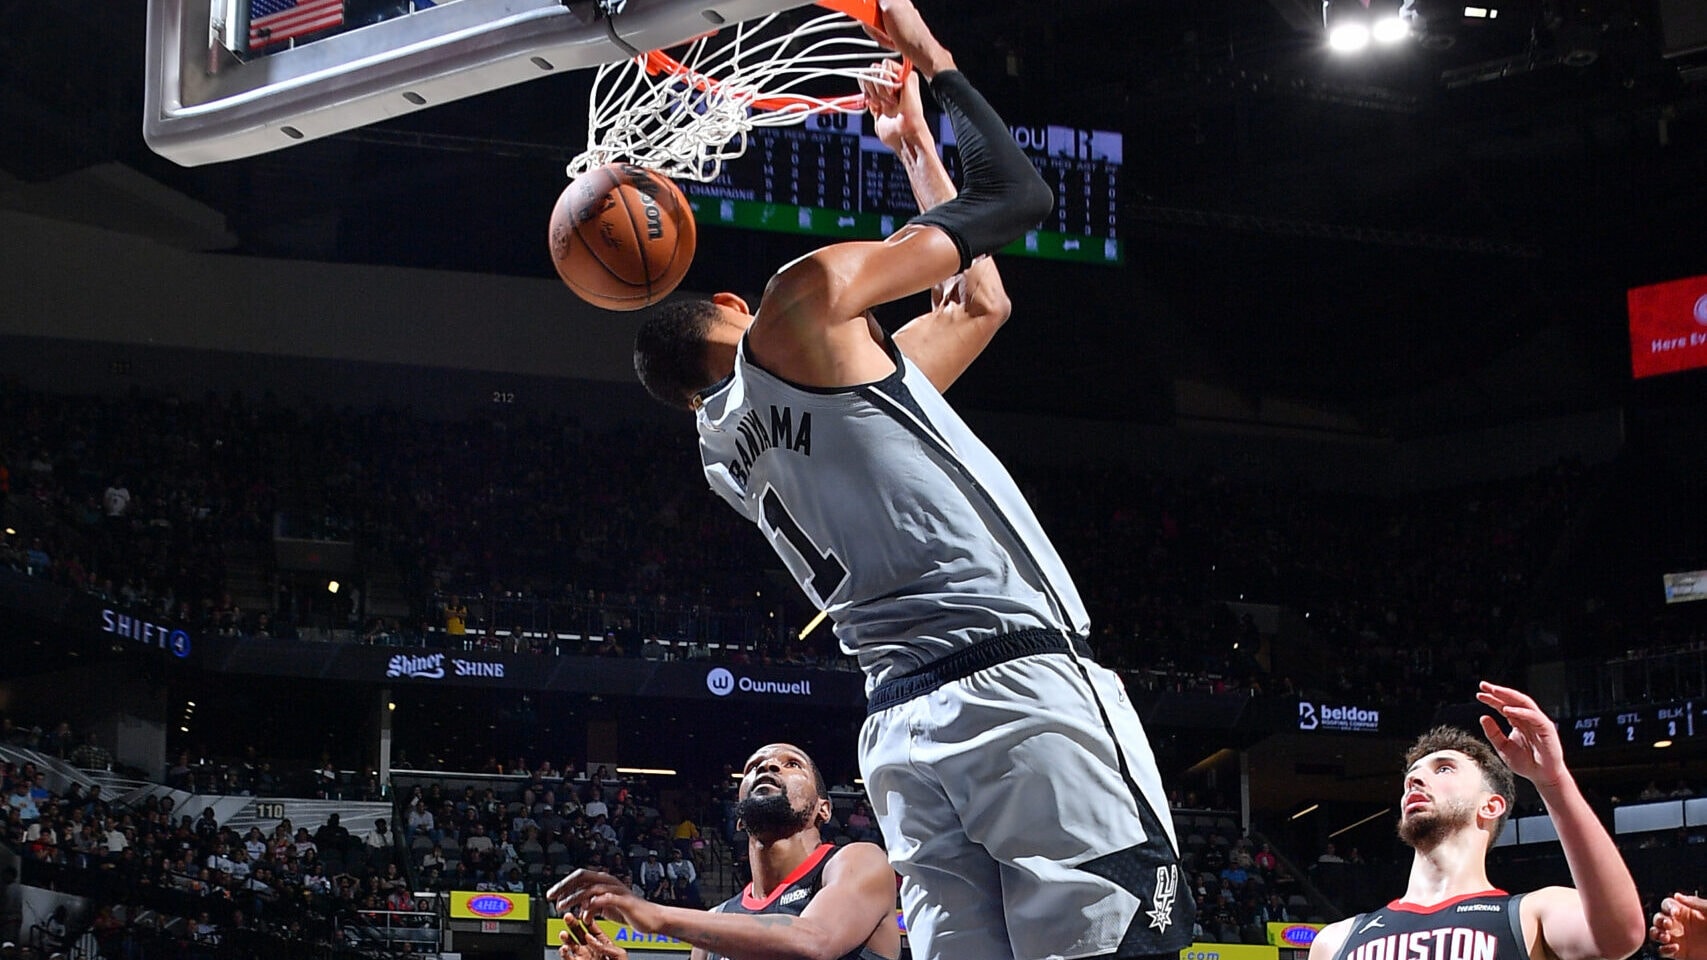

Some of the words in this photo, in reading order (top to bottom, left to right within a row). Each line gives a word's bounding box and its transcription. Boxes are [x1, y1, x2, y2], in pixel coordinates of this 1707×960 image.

[1009, 126, 1046, 151] OU
[1690, 332, 1707, 347] Ev
[493, 391, 514, 403] 212
[759, 482, 850, 609] 1
[102, 609, 169, 649] SHIFT
[386, 653, 445, 679] Shiner
[739, 676, 811, 695] Ownwell
[1321, 704, 1379, 722] beldon
[1575, 716, 1600, 729] AST
[1617, 712, 1641, 724] STL
[1658, 707, 1683, 720] BLK
[1583, 730, 1596, 746] 22
[1627, 725, 1634, 741] 2
[258, 804, 283, 818] 110
